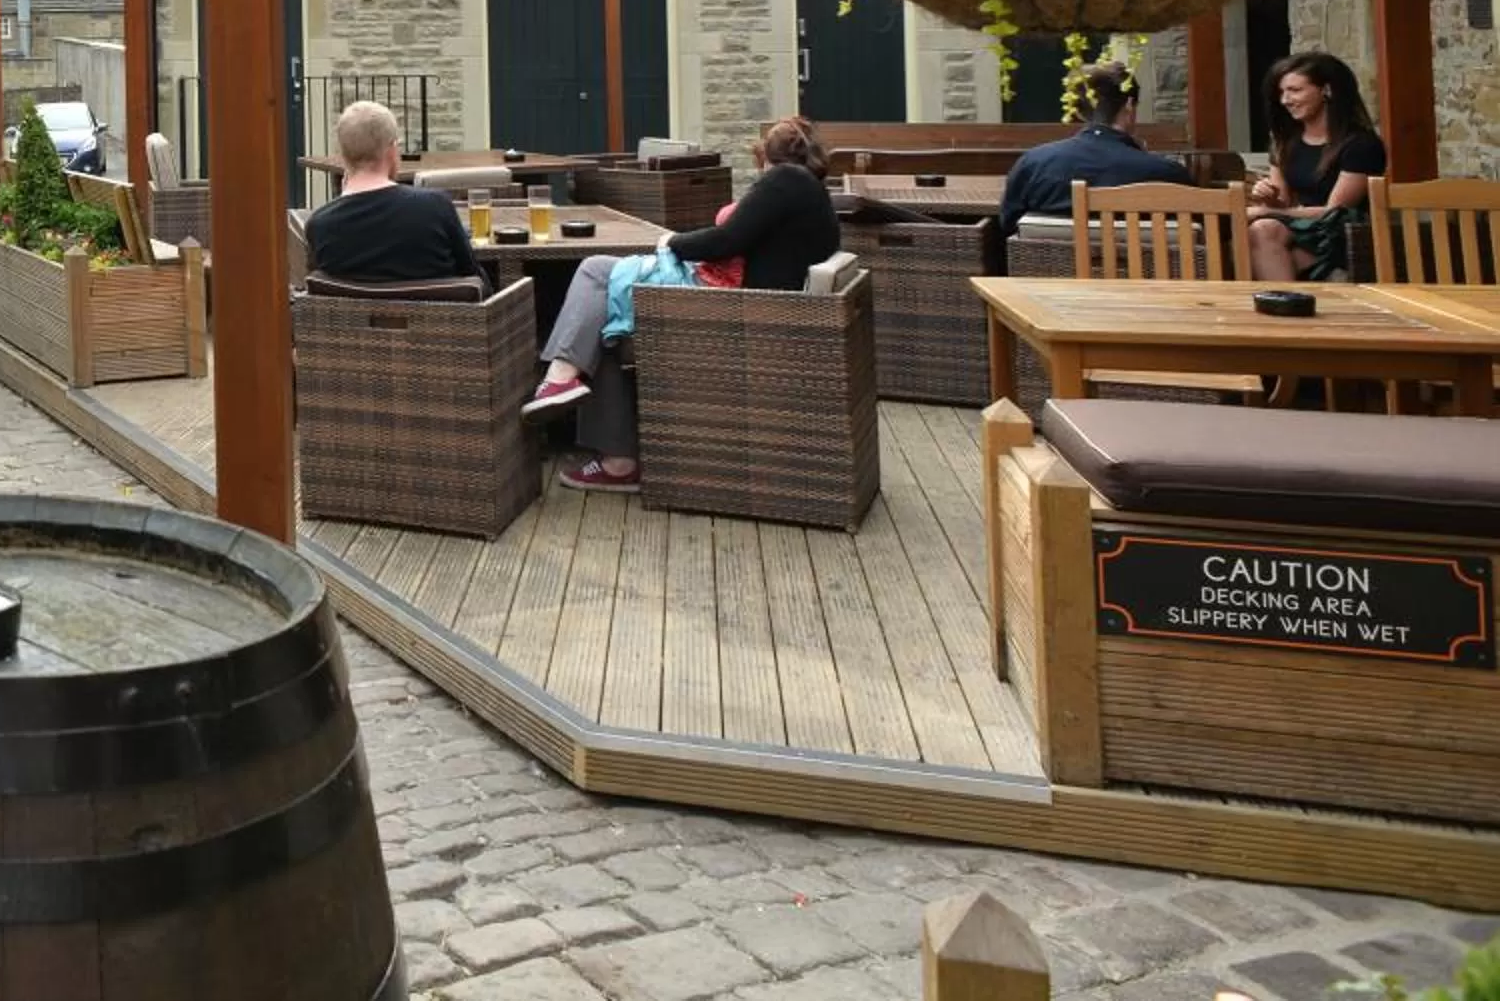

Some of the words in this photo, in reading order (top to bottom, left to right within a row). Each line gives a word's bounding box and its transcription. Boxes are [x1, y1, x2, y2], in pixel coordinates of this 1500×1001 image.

[1203, 556, 1370, 594] CAUTION
[1201, 586, 1300, 610] DECKING
[1310, 597, 1372, 618] AREA
[1167, 606, 1269, 630] SLIPPERY
[1279, 616, 1347, 639] WHEN
[1357, 623, 1410, 644] WET
